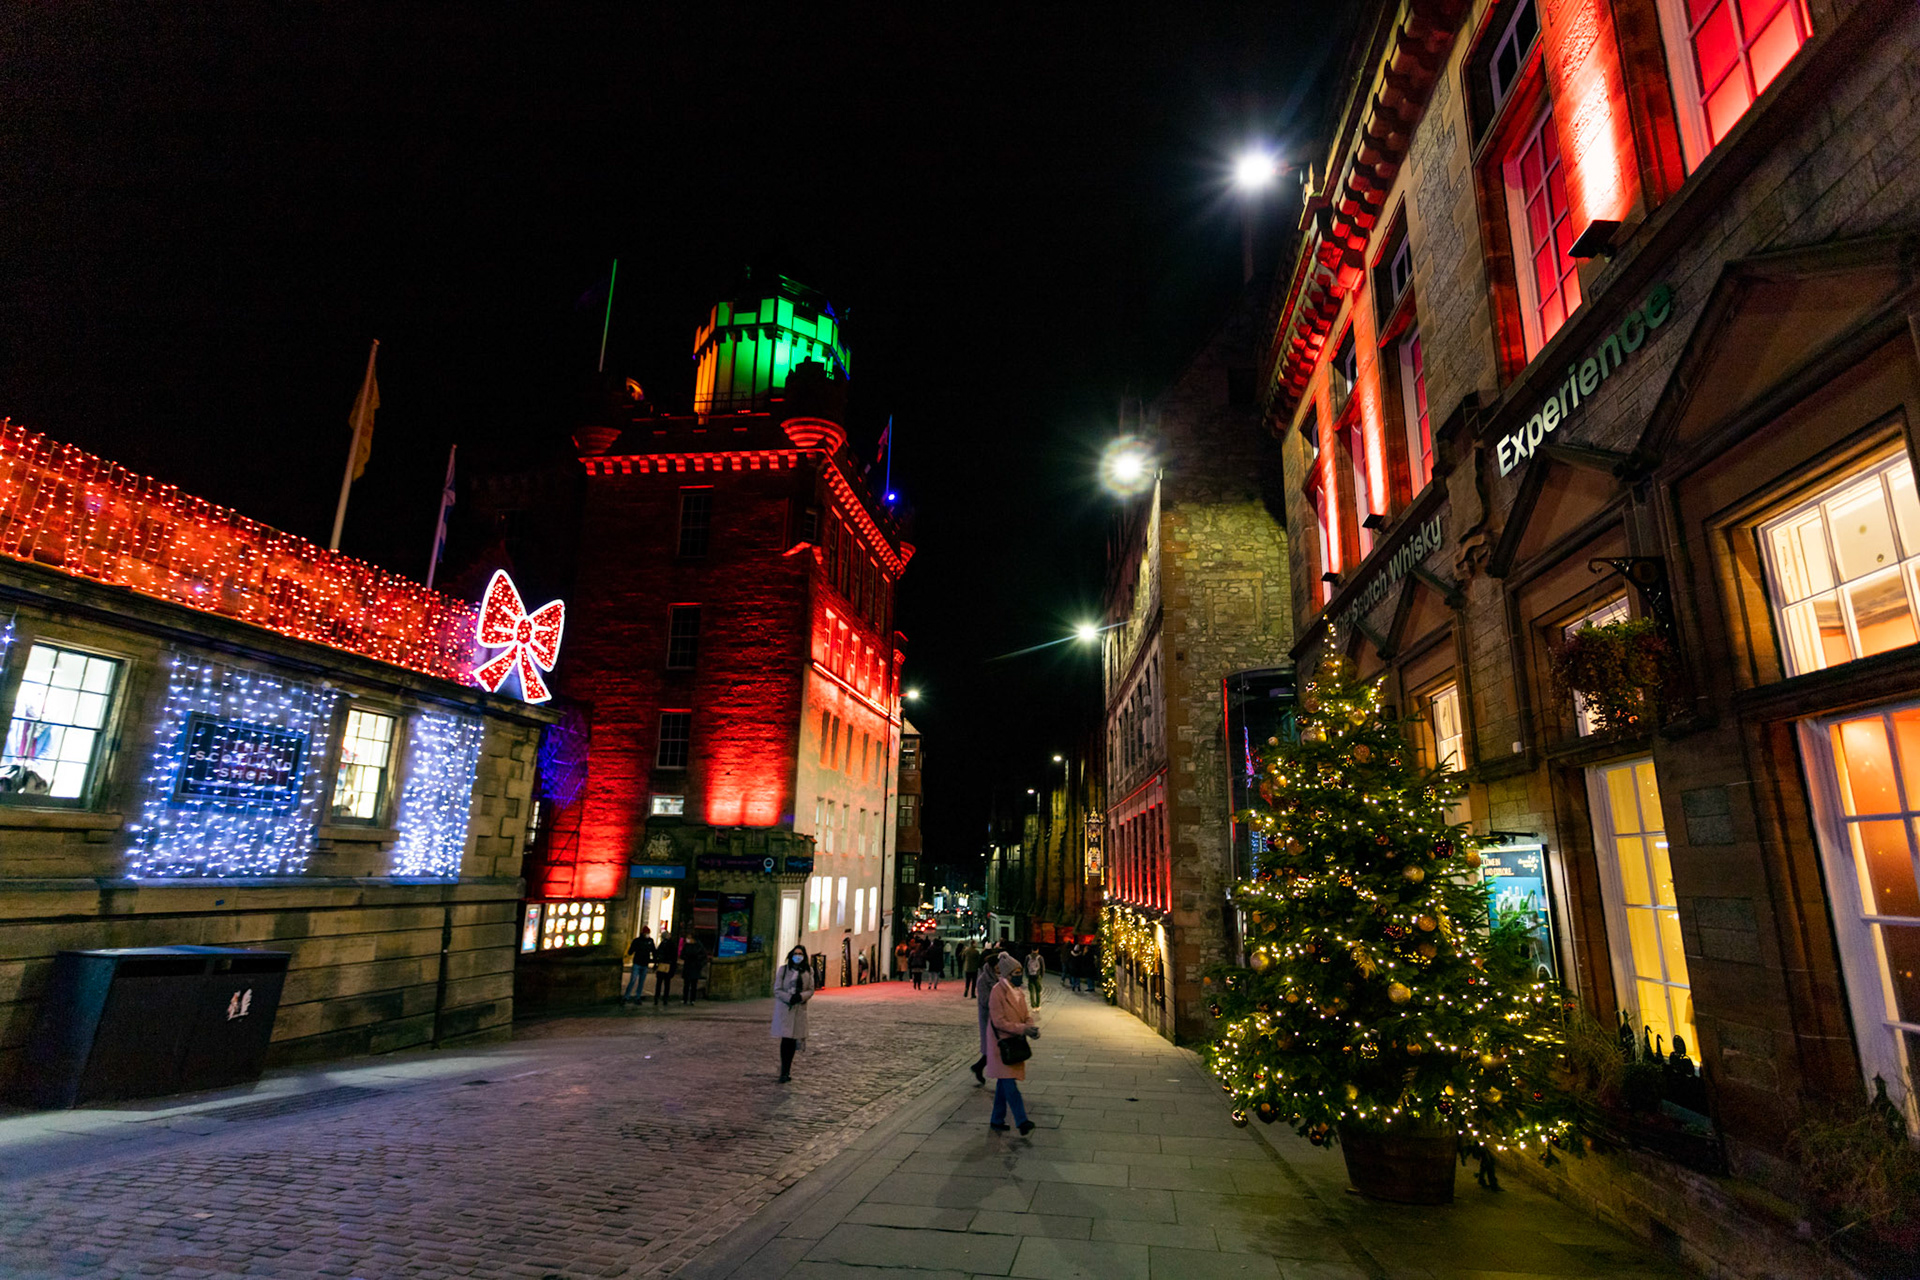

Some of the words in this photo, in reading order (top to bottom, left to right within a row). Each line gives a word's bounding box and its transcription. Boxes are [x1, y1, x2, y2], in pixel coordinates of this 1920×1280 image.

[1351, 569, 1387, 623] Scotch
[1389, 515, 1442, 583] Whisky
[1496, 283, 1674, 479] Experience
[233, 741, 268, 754] THE
[195, 750, 293, 770] SCOTLAND
[219, 767, 269, 781] SHOP
